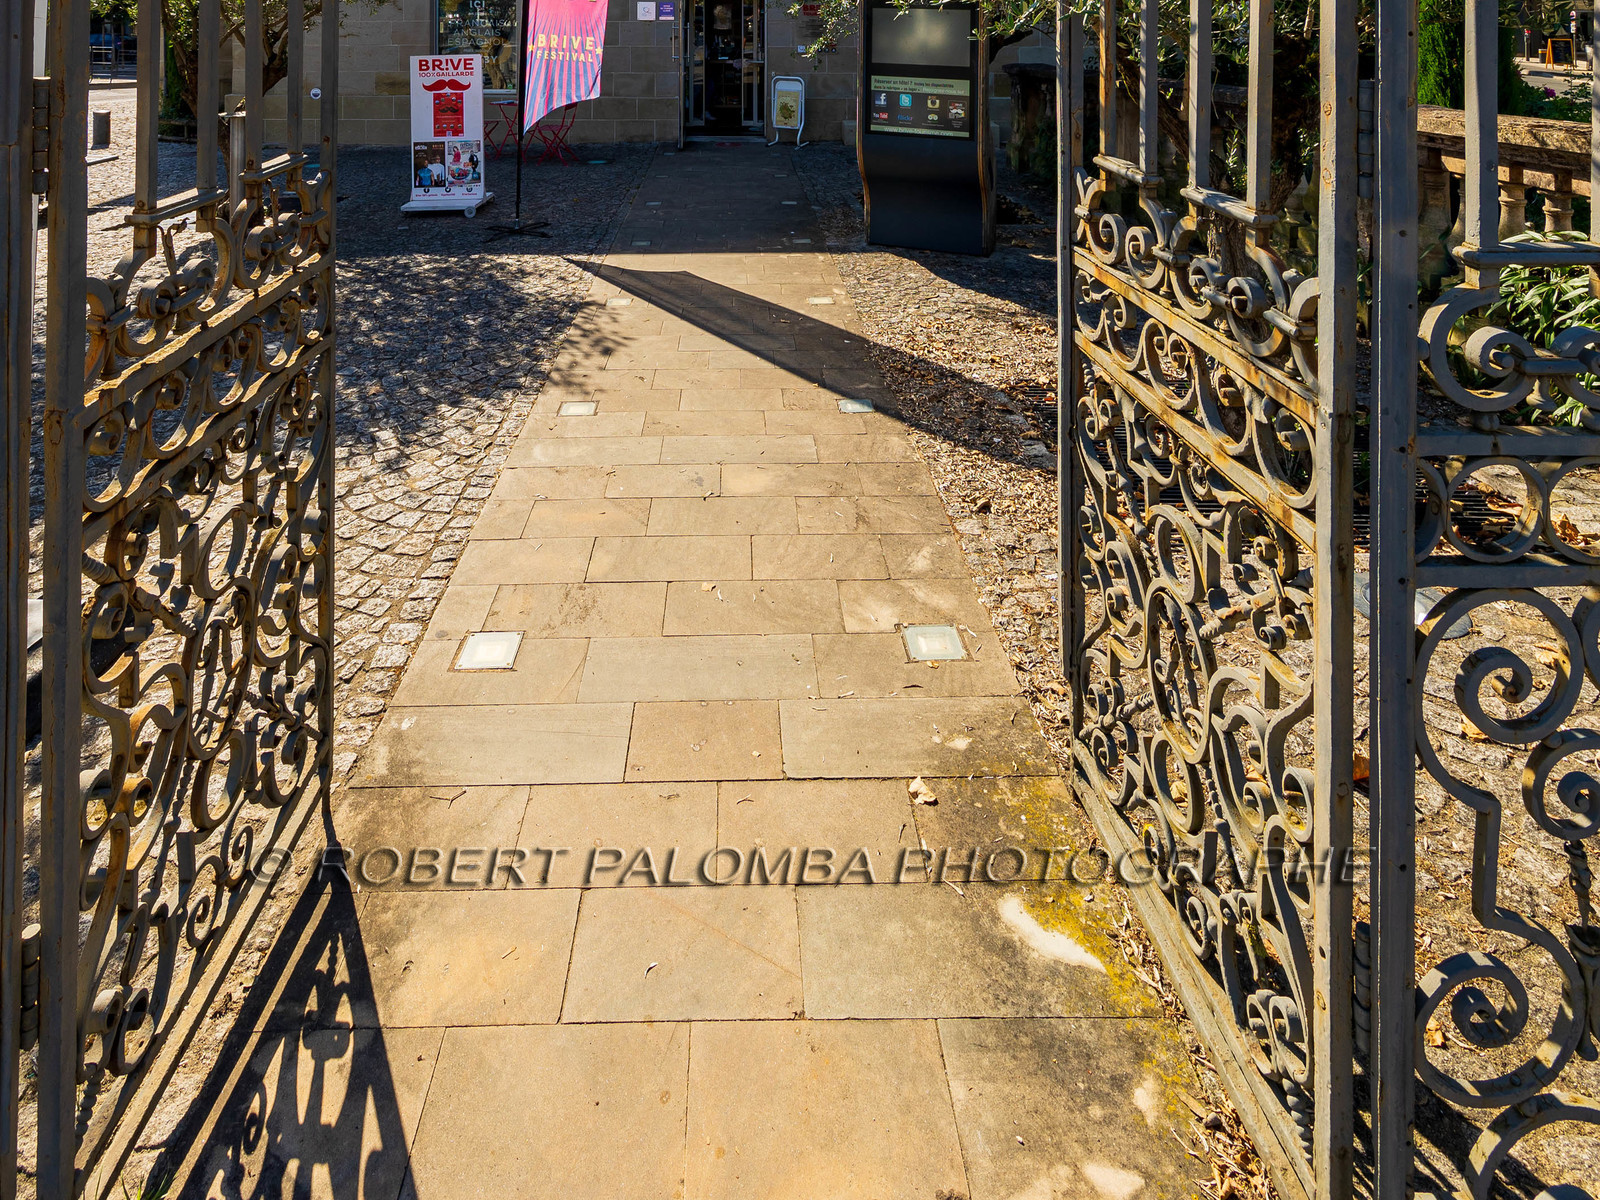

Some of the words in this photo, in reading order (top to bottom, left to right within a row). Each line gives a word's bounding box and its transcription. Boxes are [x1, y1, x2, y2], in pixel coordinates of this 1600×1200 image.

[469, 0, 486, 8] ICI
[454, 29, 501, 37] ANGLAIS
[447, 38, 505, 46] ESPAGNOL
[537, 33, 595, 50] BRIVE
[536, 49, 594, 63] FESTIVAL
